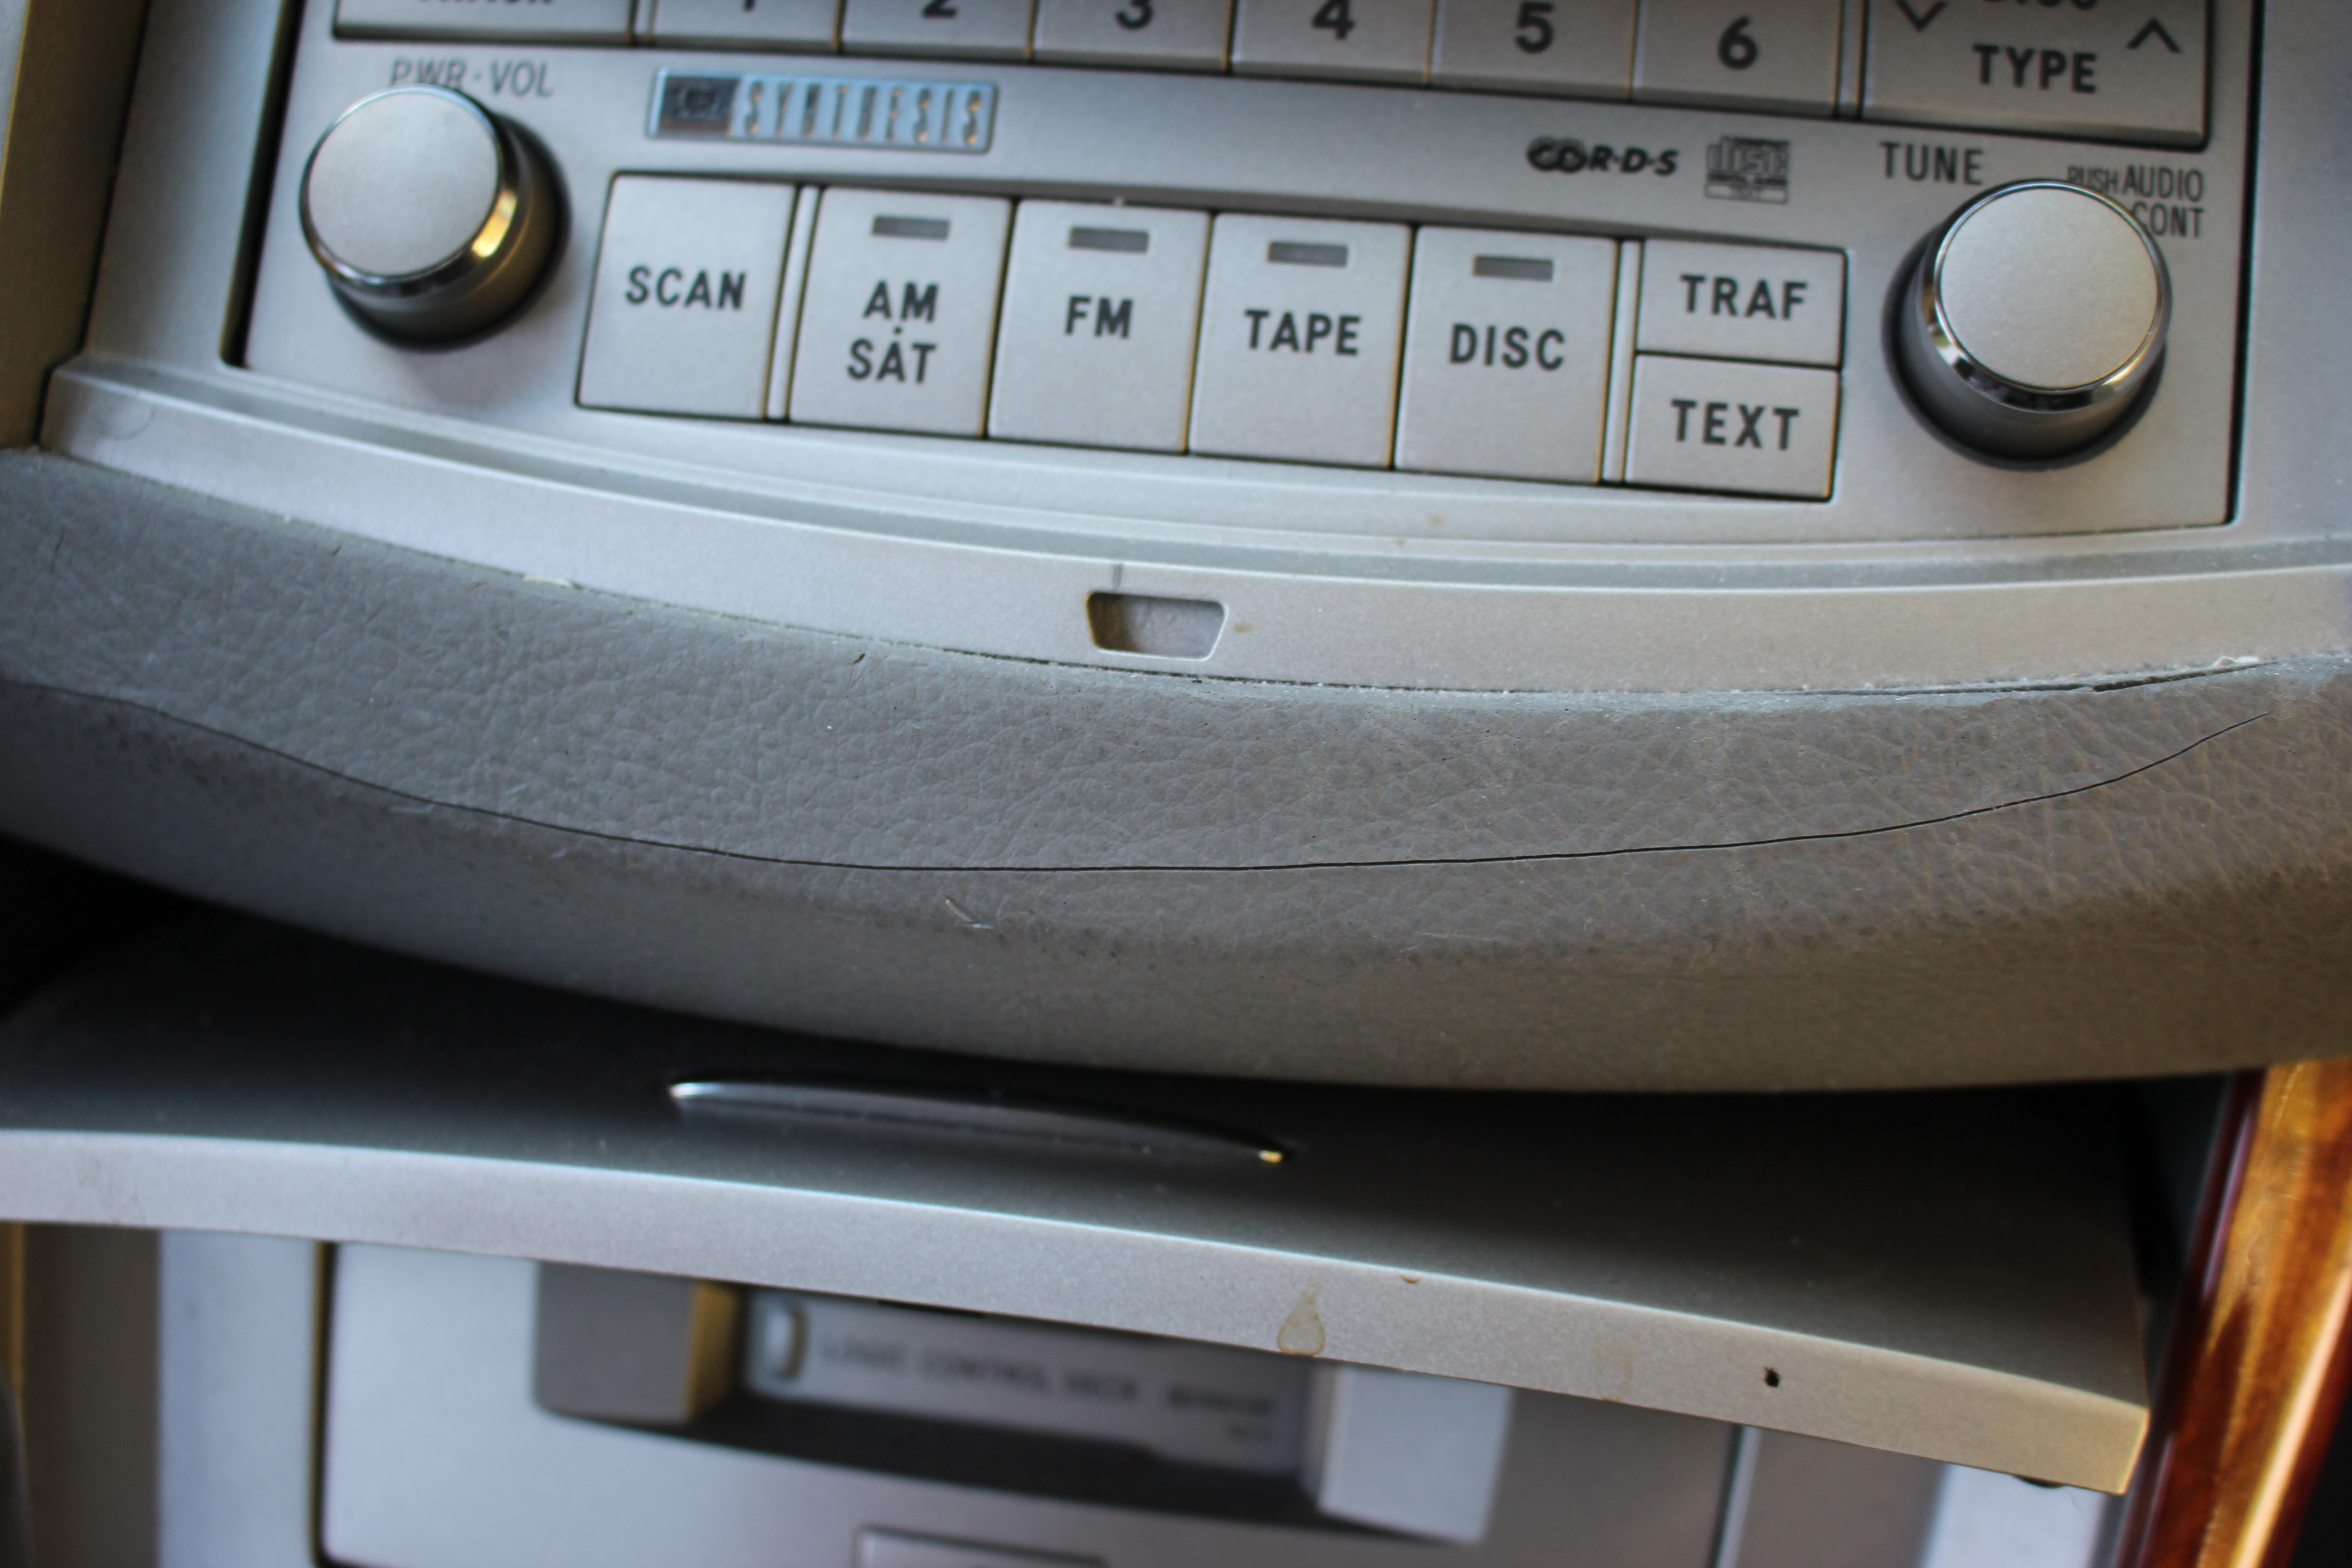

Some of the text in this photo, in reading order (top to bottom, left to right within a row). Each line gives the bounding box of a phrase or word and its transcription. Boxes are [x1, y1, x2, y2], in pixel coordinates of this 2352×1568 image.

[1311, 0, 1356, 40] 4
[1514, 1, 1554, 54] 5
[1717, 16, 1759, 70] 6
[1973, 44, 2097, 93] TYPE
[1880, 141, 1983, 185] TUNE
[2122, 164, 2204, 202] AUDIO
[2131, 201, 2205, 238] CONT
[625, 266, 746, 310] SCAN
[862, 280, 939, 323] AM
[1680, 274, 1808, 319] TRAF
[1064, 295, 1134, 339] FM
[1245, 309, 1361, 356] TAPE
[847, 338, 936, 384] SAT
[1449, 323, 1565, 371] DISC
[1671, 399, 1800, 451] TEXT
